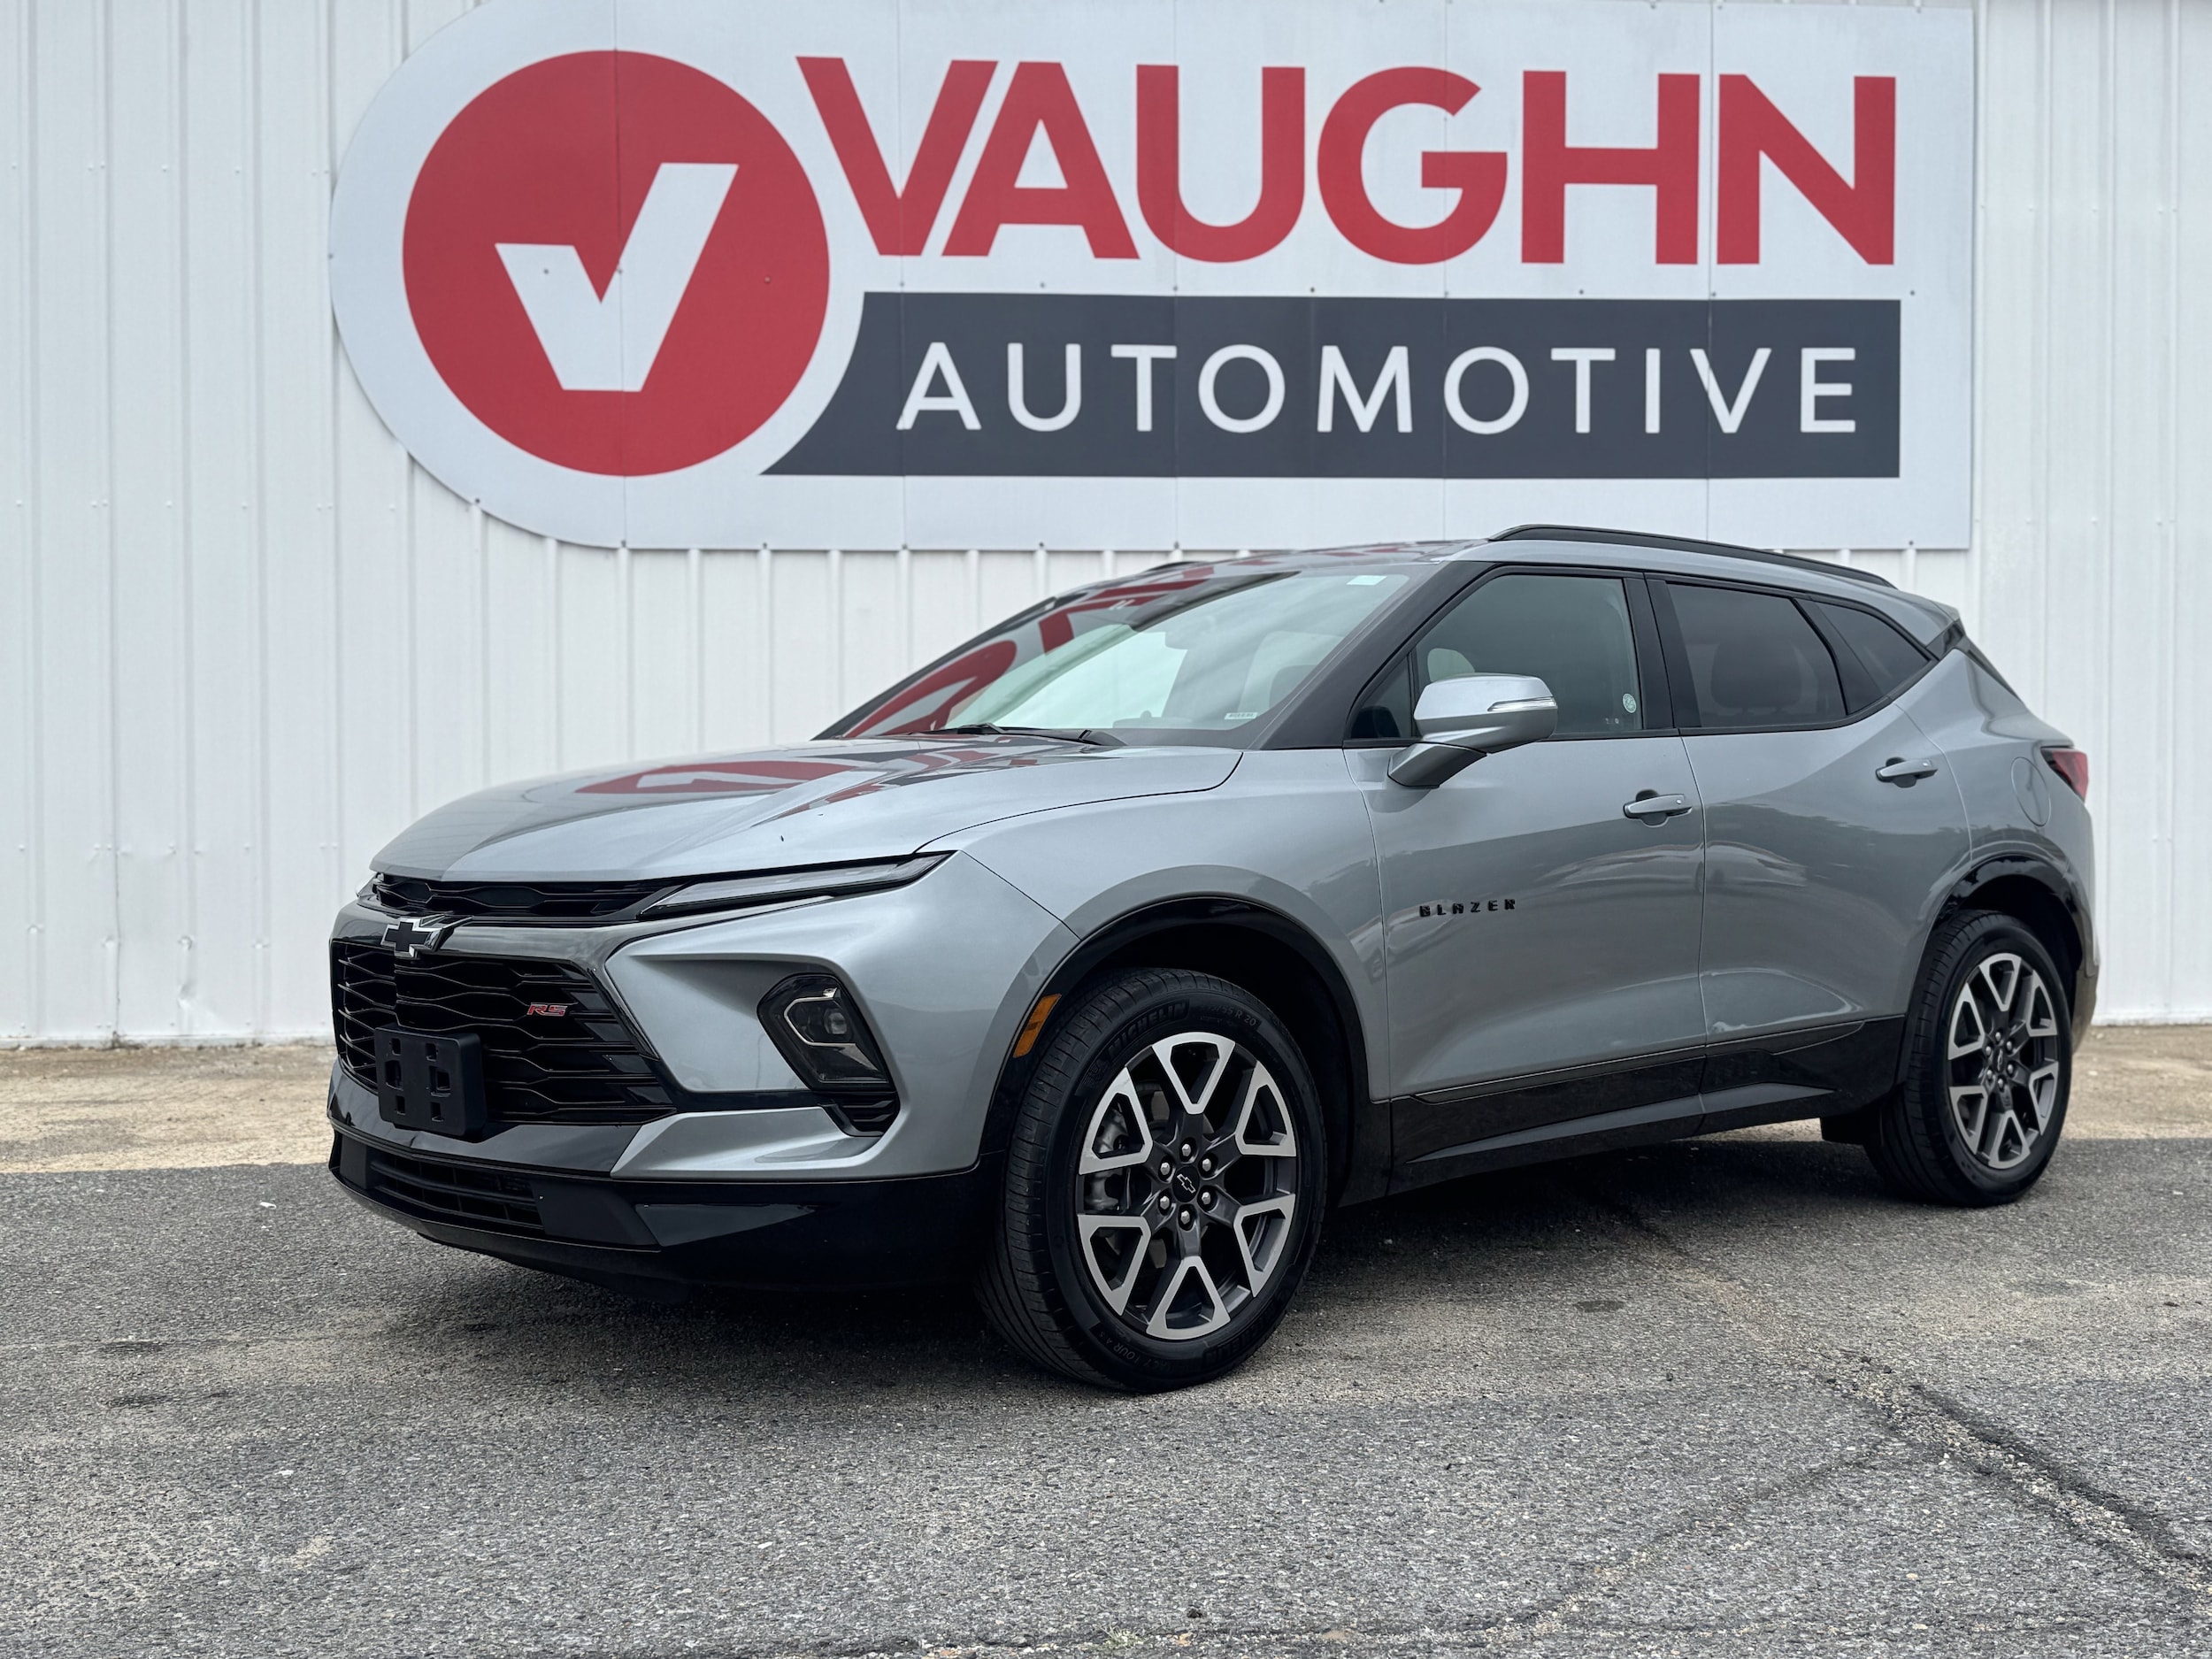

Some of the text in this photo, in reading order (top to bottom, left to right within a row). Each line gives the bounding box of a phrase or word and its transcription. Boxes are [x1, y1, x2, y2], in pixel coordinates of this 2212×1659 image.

[797, 56, 1896, 265] VAUGHN
[896, 342, 1856, 434] AUTOMOTIVE
[1419, 899, 1515, 917] BLAZER
[526, 1003, 568, 1017] RS
[1244, 1014, 1257, 1026] 20
[1106, 1001, 1187, 1058] MICHELIN
